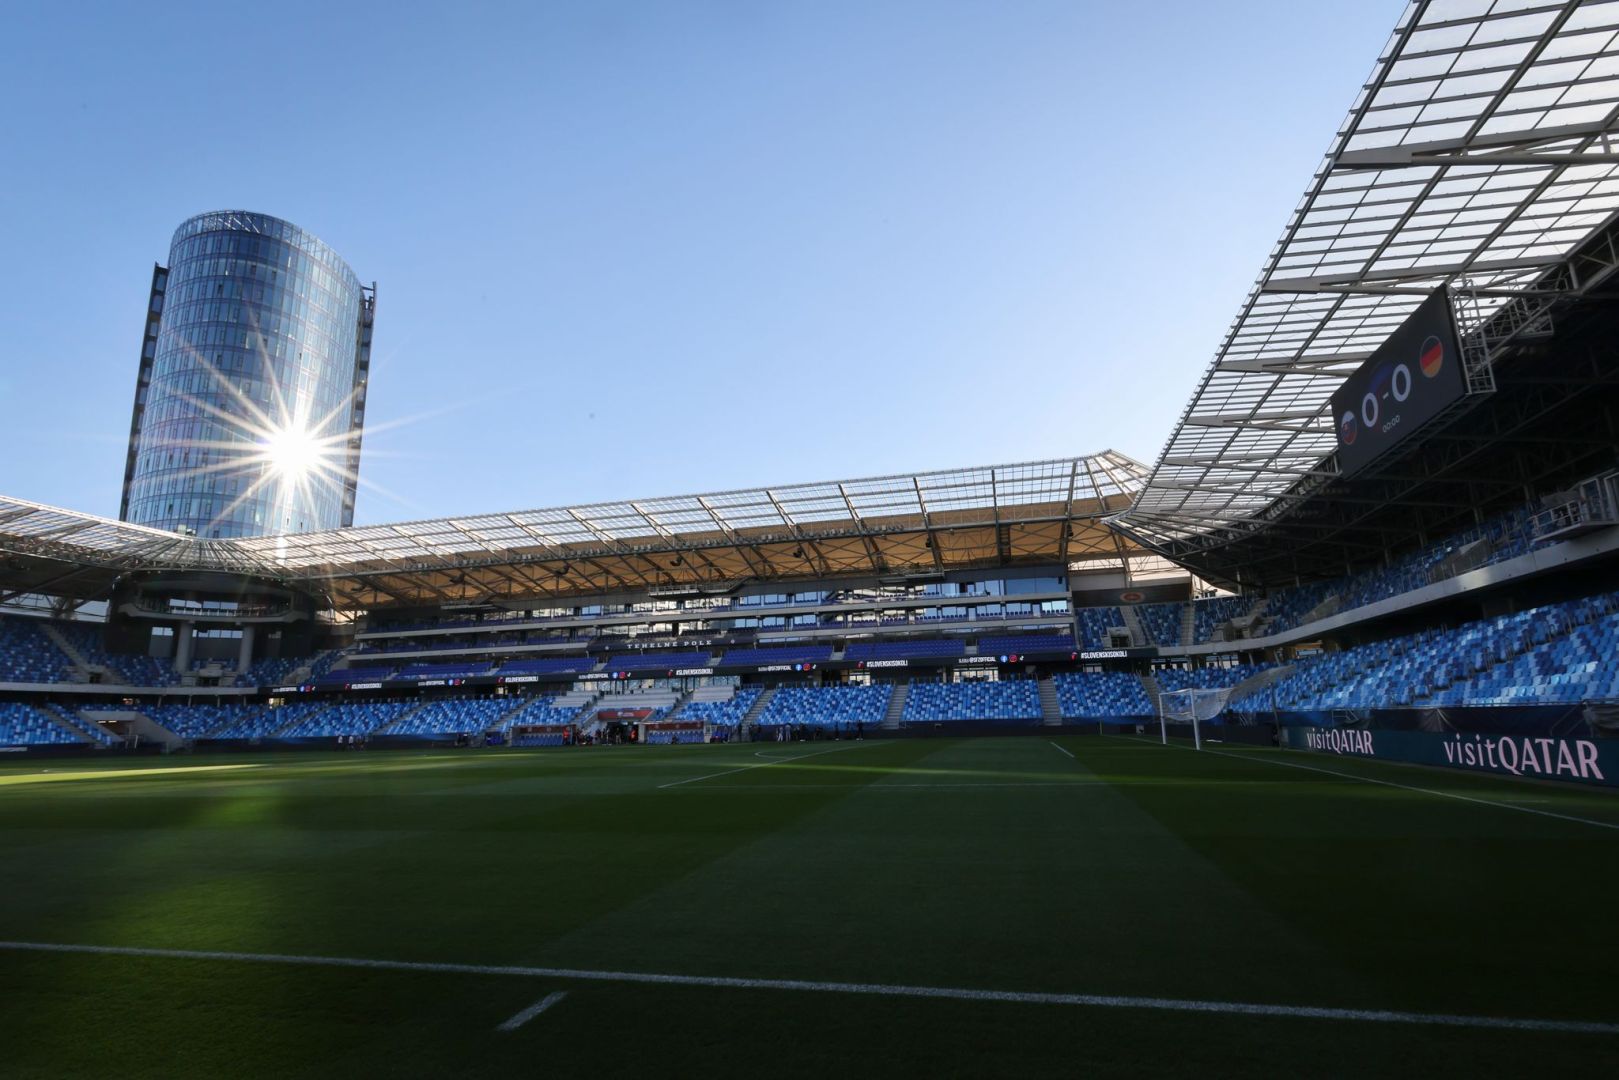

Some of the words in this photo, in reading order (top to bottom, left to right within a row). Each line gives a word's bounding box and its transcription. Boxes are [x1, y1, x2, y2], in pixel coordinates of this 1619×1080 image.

[1362, 392, 1379, 428] 0
[1392, 363, 1411, 402] 0
[1382, 415, 1401, 433] 00:00
[684, 639, 712, 647] POLE
[1306, 728, 1375, 755] visitQATAR
[1443, 732, 1604, 780] visitQATAR
